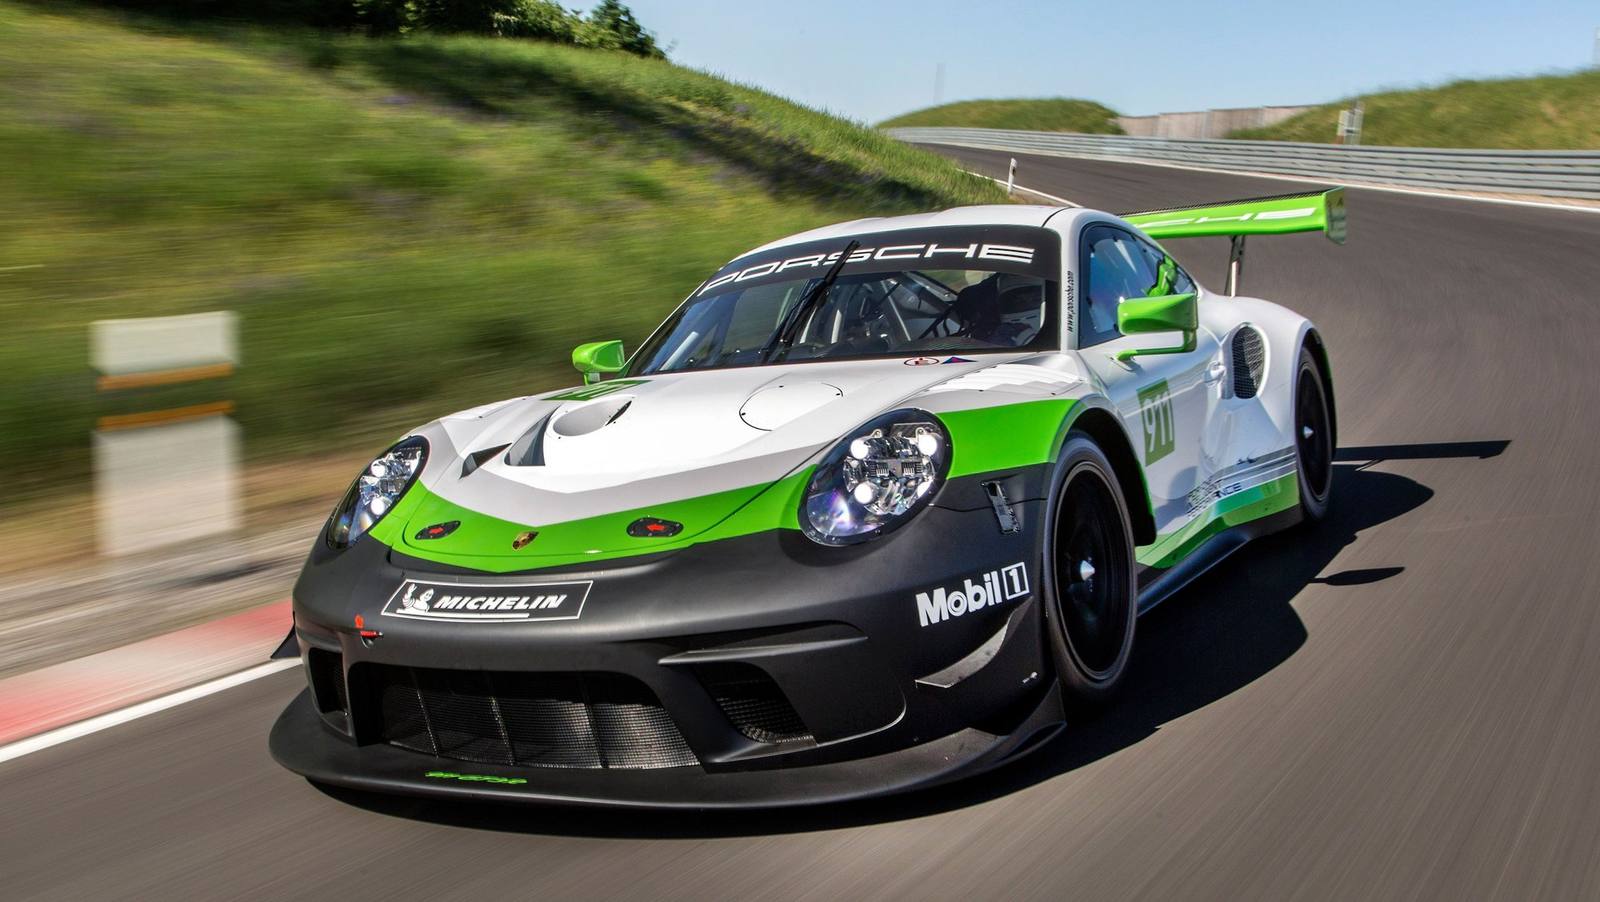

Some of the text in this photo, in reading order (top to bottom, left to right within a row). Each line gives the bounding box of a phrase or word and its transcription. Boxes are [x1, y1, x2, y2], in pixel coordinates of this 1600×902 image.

[697, 243, 1035, 297] PORSCHE
[1143, 390, 1173, 453] 911
[433, 594, 568, 610] MICHELIN
[915, 571, 1002, 628] Mobil
